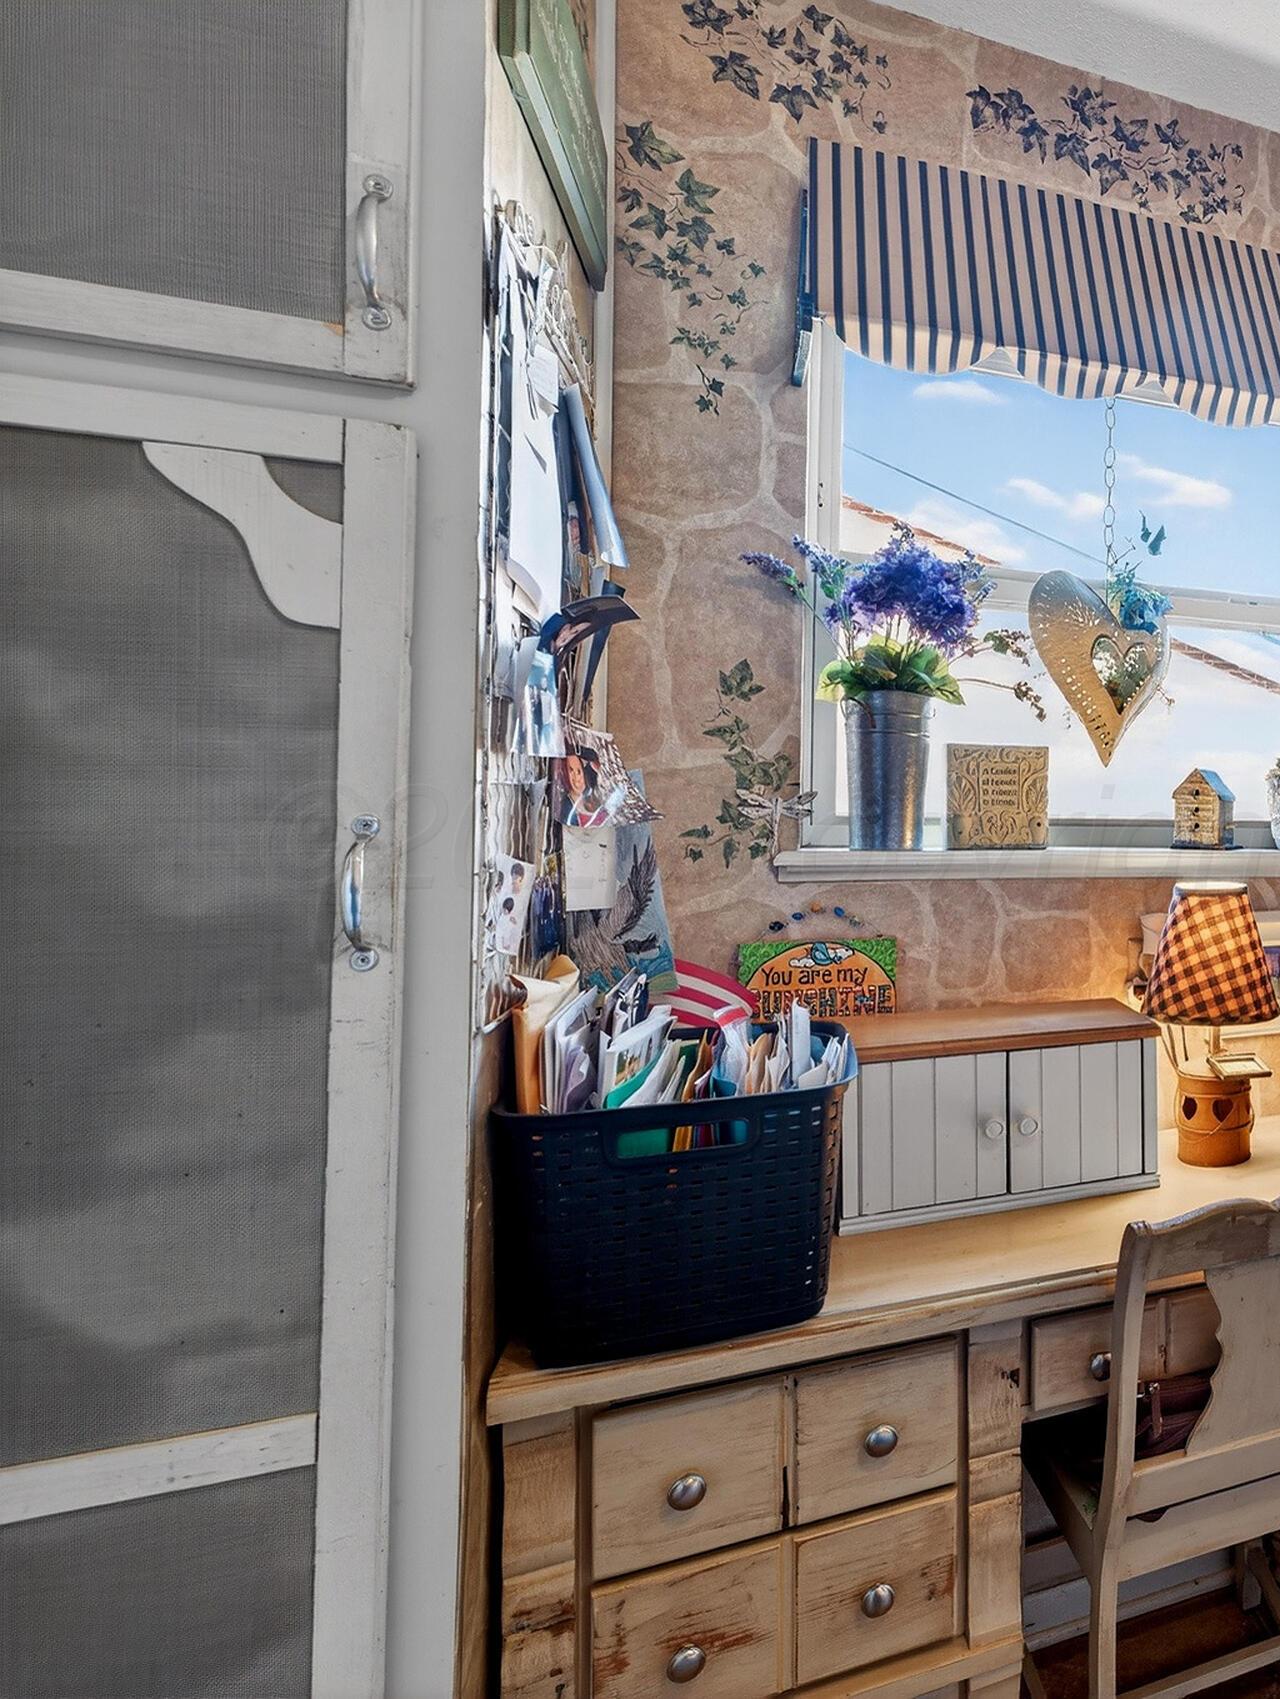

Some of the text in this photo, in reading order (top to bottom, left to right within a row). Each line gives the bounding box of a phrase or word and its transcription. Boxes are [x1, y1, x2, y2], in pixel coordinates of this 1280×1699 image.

[761, 967, 869, 986] You are my
